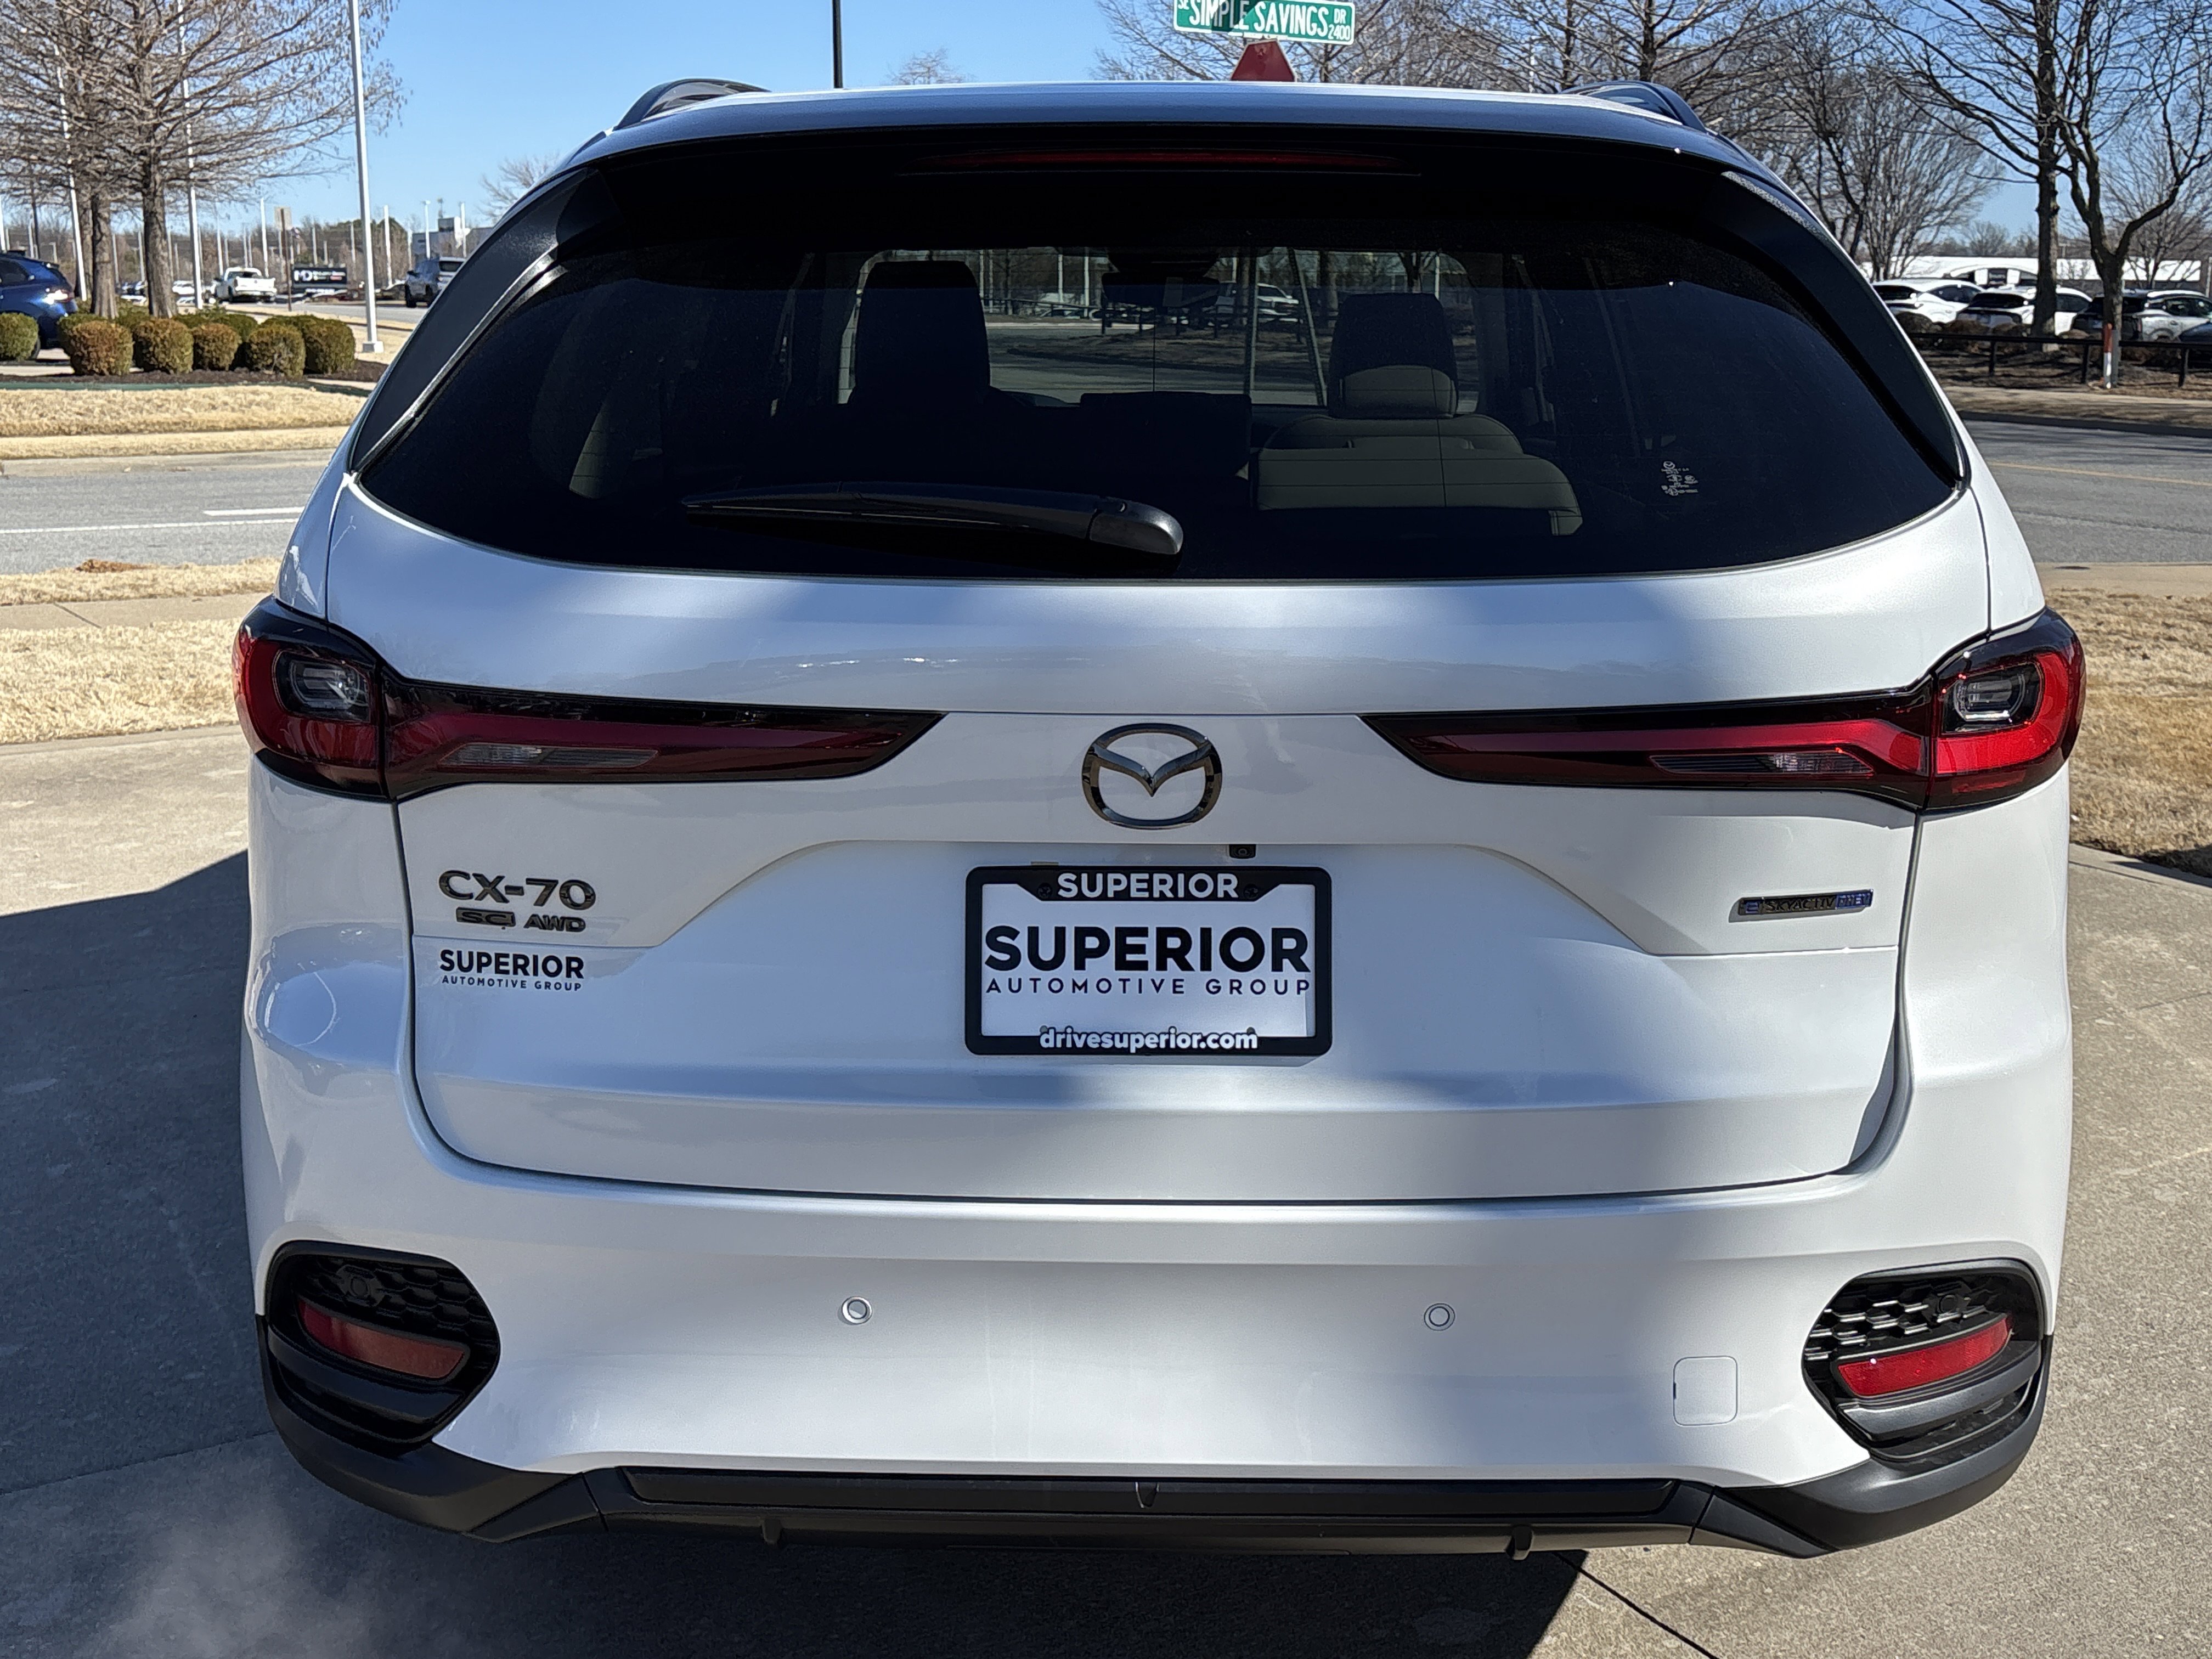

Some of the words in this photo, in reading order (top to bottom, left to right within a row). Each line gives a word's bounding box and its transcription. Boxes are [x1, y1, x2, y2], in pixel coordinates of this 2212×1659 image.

[1189, 0, 1249, 30] SIMPLE
[1254, 1, 1329, 37] SAVINGS
[1334, 9, 1346, 24] DR
[1328, 25, 1351, 40] 2400
[439, 870, 596, 910] CX-70
[1057, 873, 1238, 899] SUPERIOR
[523, 914, 586, 932] AWD
[985, 926, 1311, 973] SUPERIOR
[440, 950, 584, 979] SUPERIOR
[442, 975, 527, 989] AUTOMOTIVE
[534, 980, 582, 991] GROUP
[986, 977, 1184, 994] AUTOMOTIVE
[1206, 979, 1310, 995] GROUP
[1040, 1027, 1257, 1053] drivesuperior.com
